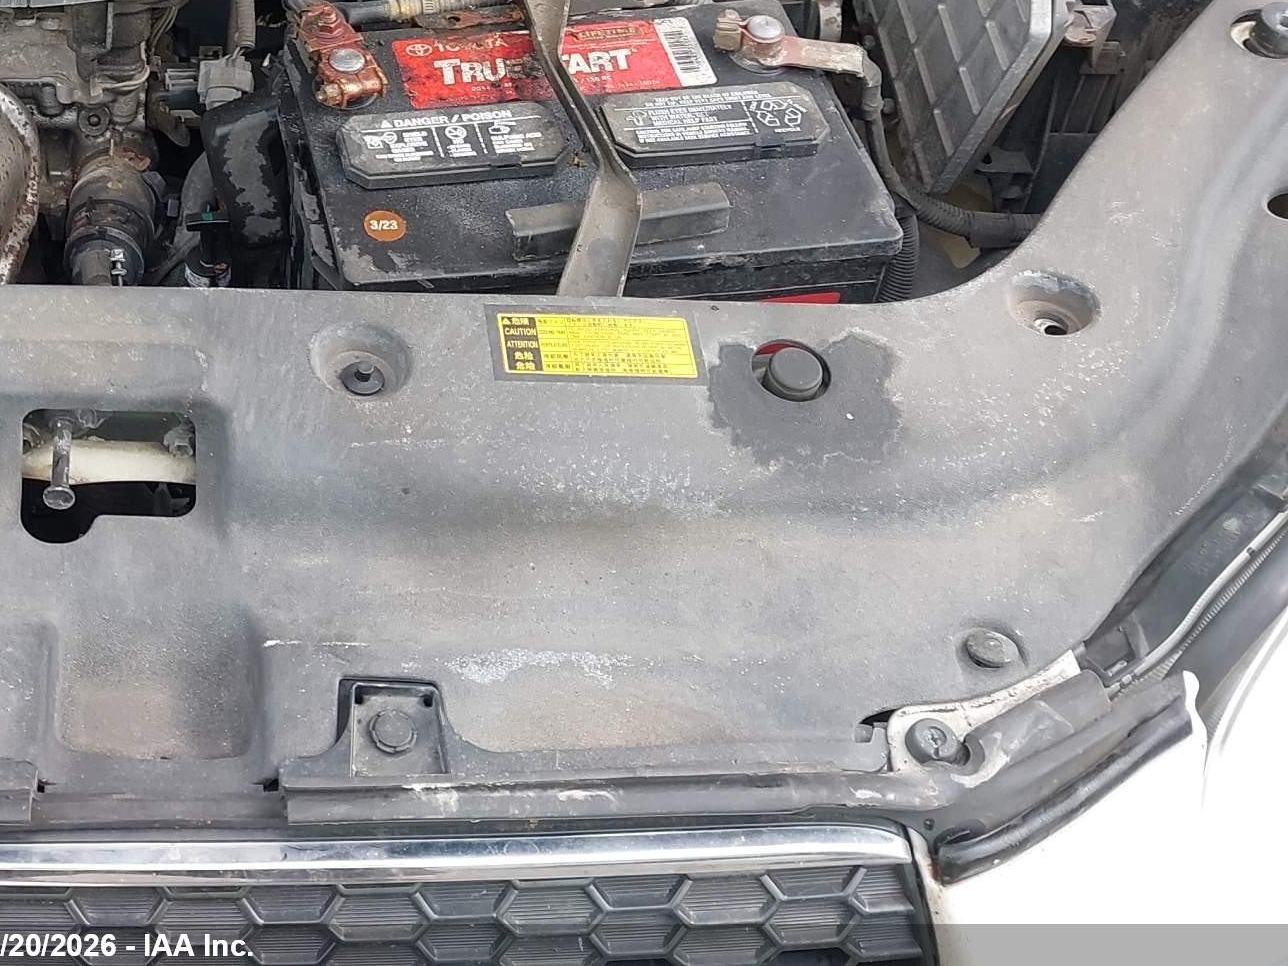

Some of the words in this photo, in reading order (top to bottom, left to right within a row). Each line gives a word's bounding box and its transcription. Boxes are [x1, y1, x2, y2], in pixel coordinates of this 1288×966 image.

[393, 116, 449, 127] DANGER
[461, 109, 513, 122] POISON
[370, 219, 399, 231] 3/23
[504, 327, 537, 336] CAUTION
[506, 340, 539, 349] ATTENTION
